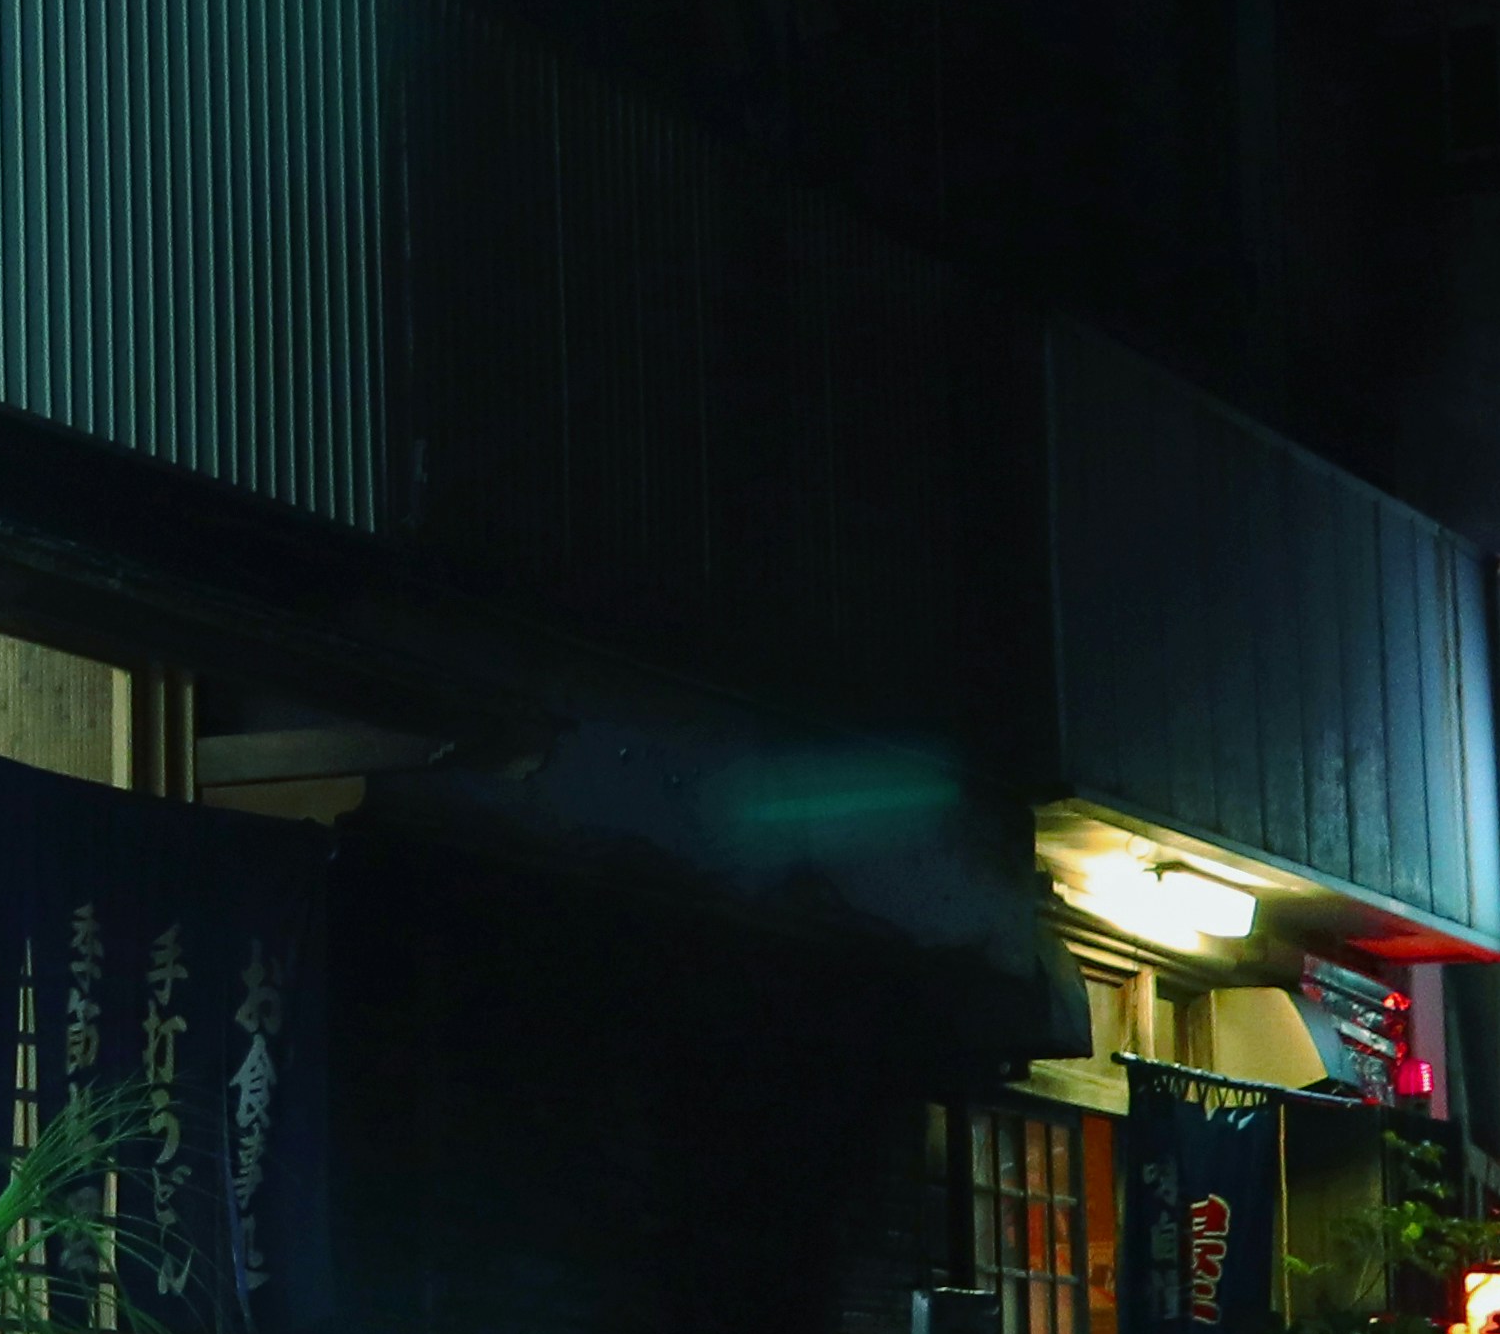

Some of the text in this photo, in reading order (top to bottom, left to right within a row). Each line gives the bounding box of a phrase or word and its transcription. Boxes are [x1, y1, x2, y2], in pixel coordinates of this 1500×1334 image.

[142, 923, 194, 1297] 手打うどん
